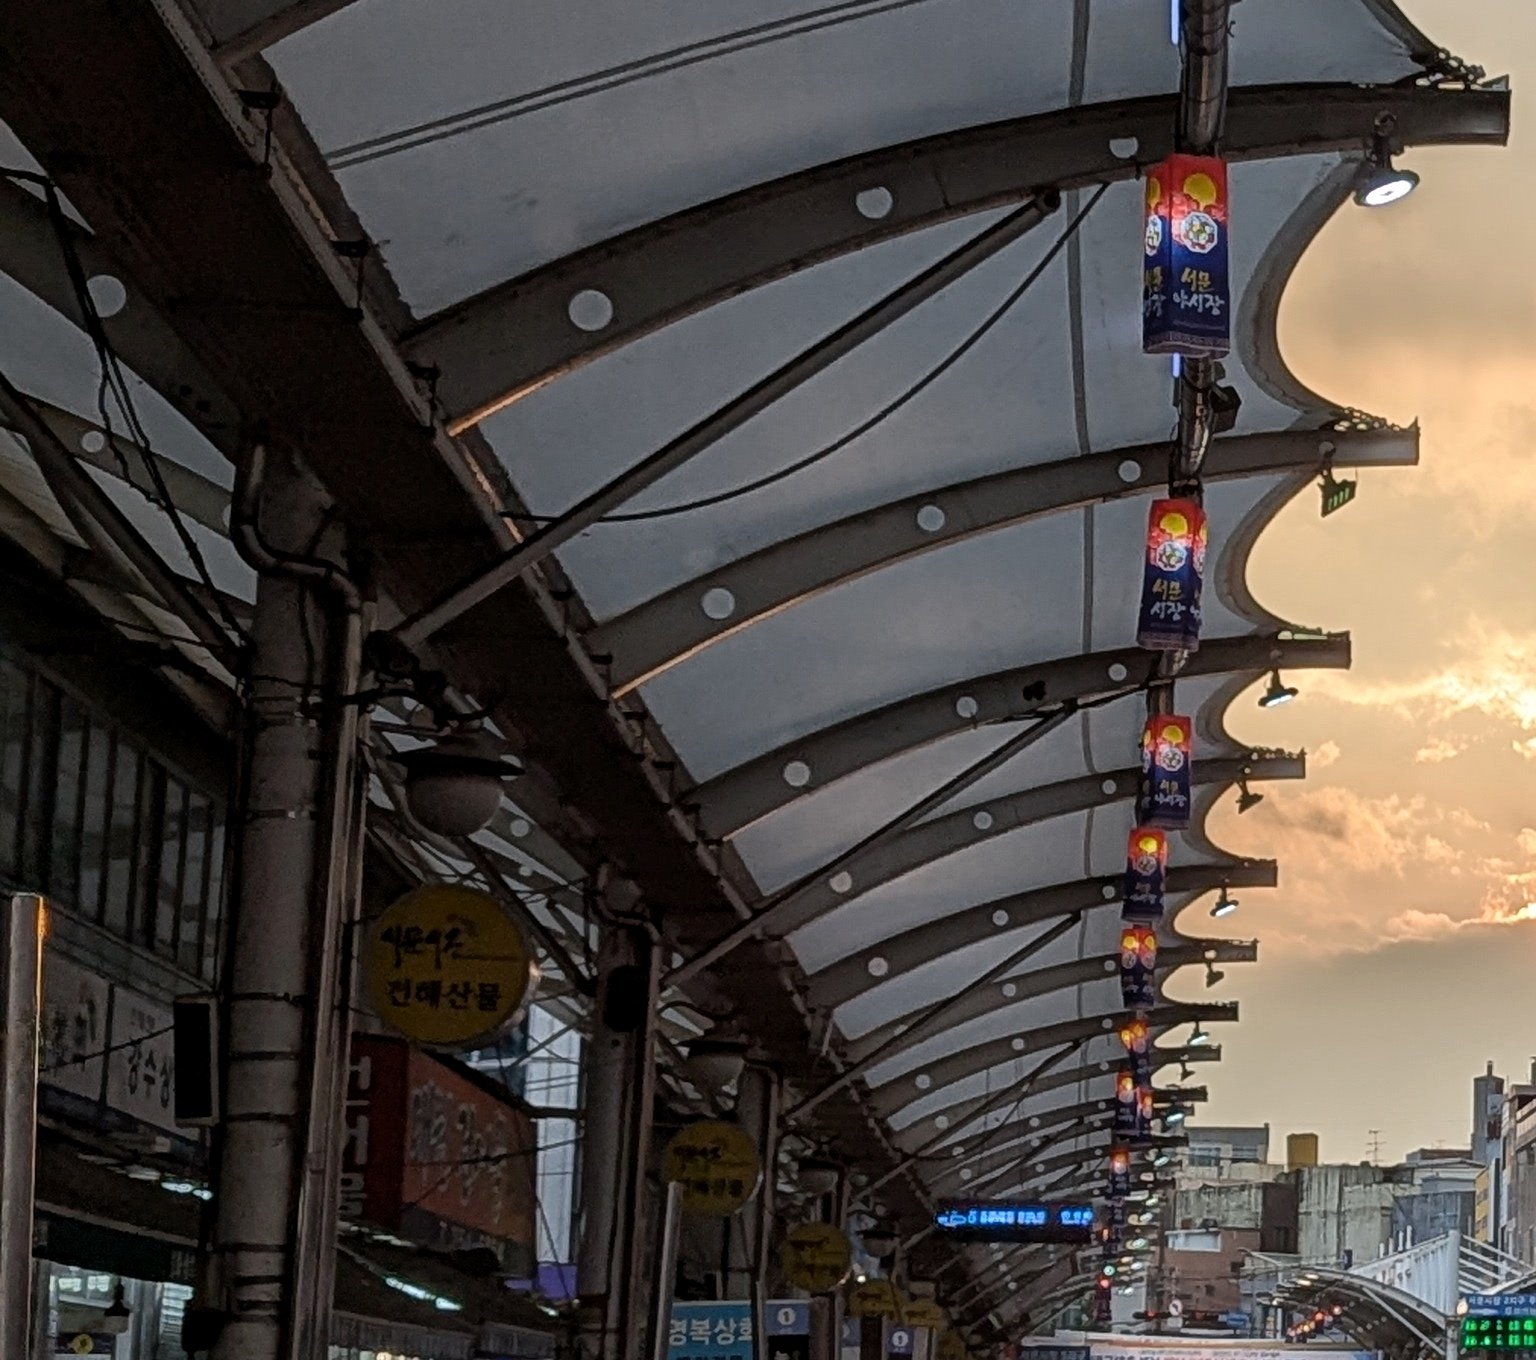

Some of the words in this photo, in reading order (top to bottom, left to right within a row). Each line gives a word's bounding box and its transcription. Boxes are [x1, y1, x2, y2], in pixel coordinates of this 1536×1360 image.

[1181, 266, 1212, 291] 서문
[1173, 290, 1225, 316] 야시장
[386, 978, 501, 1011] 건해산물
